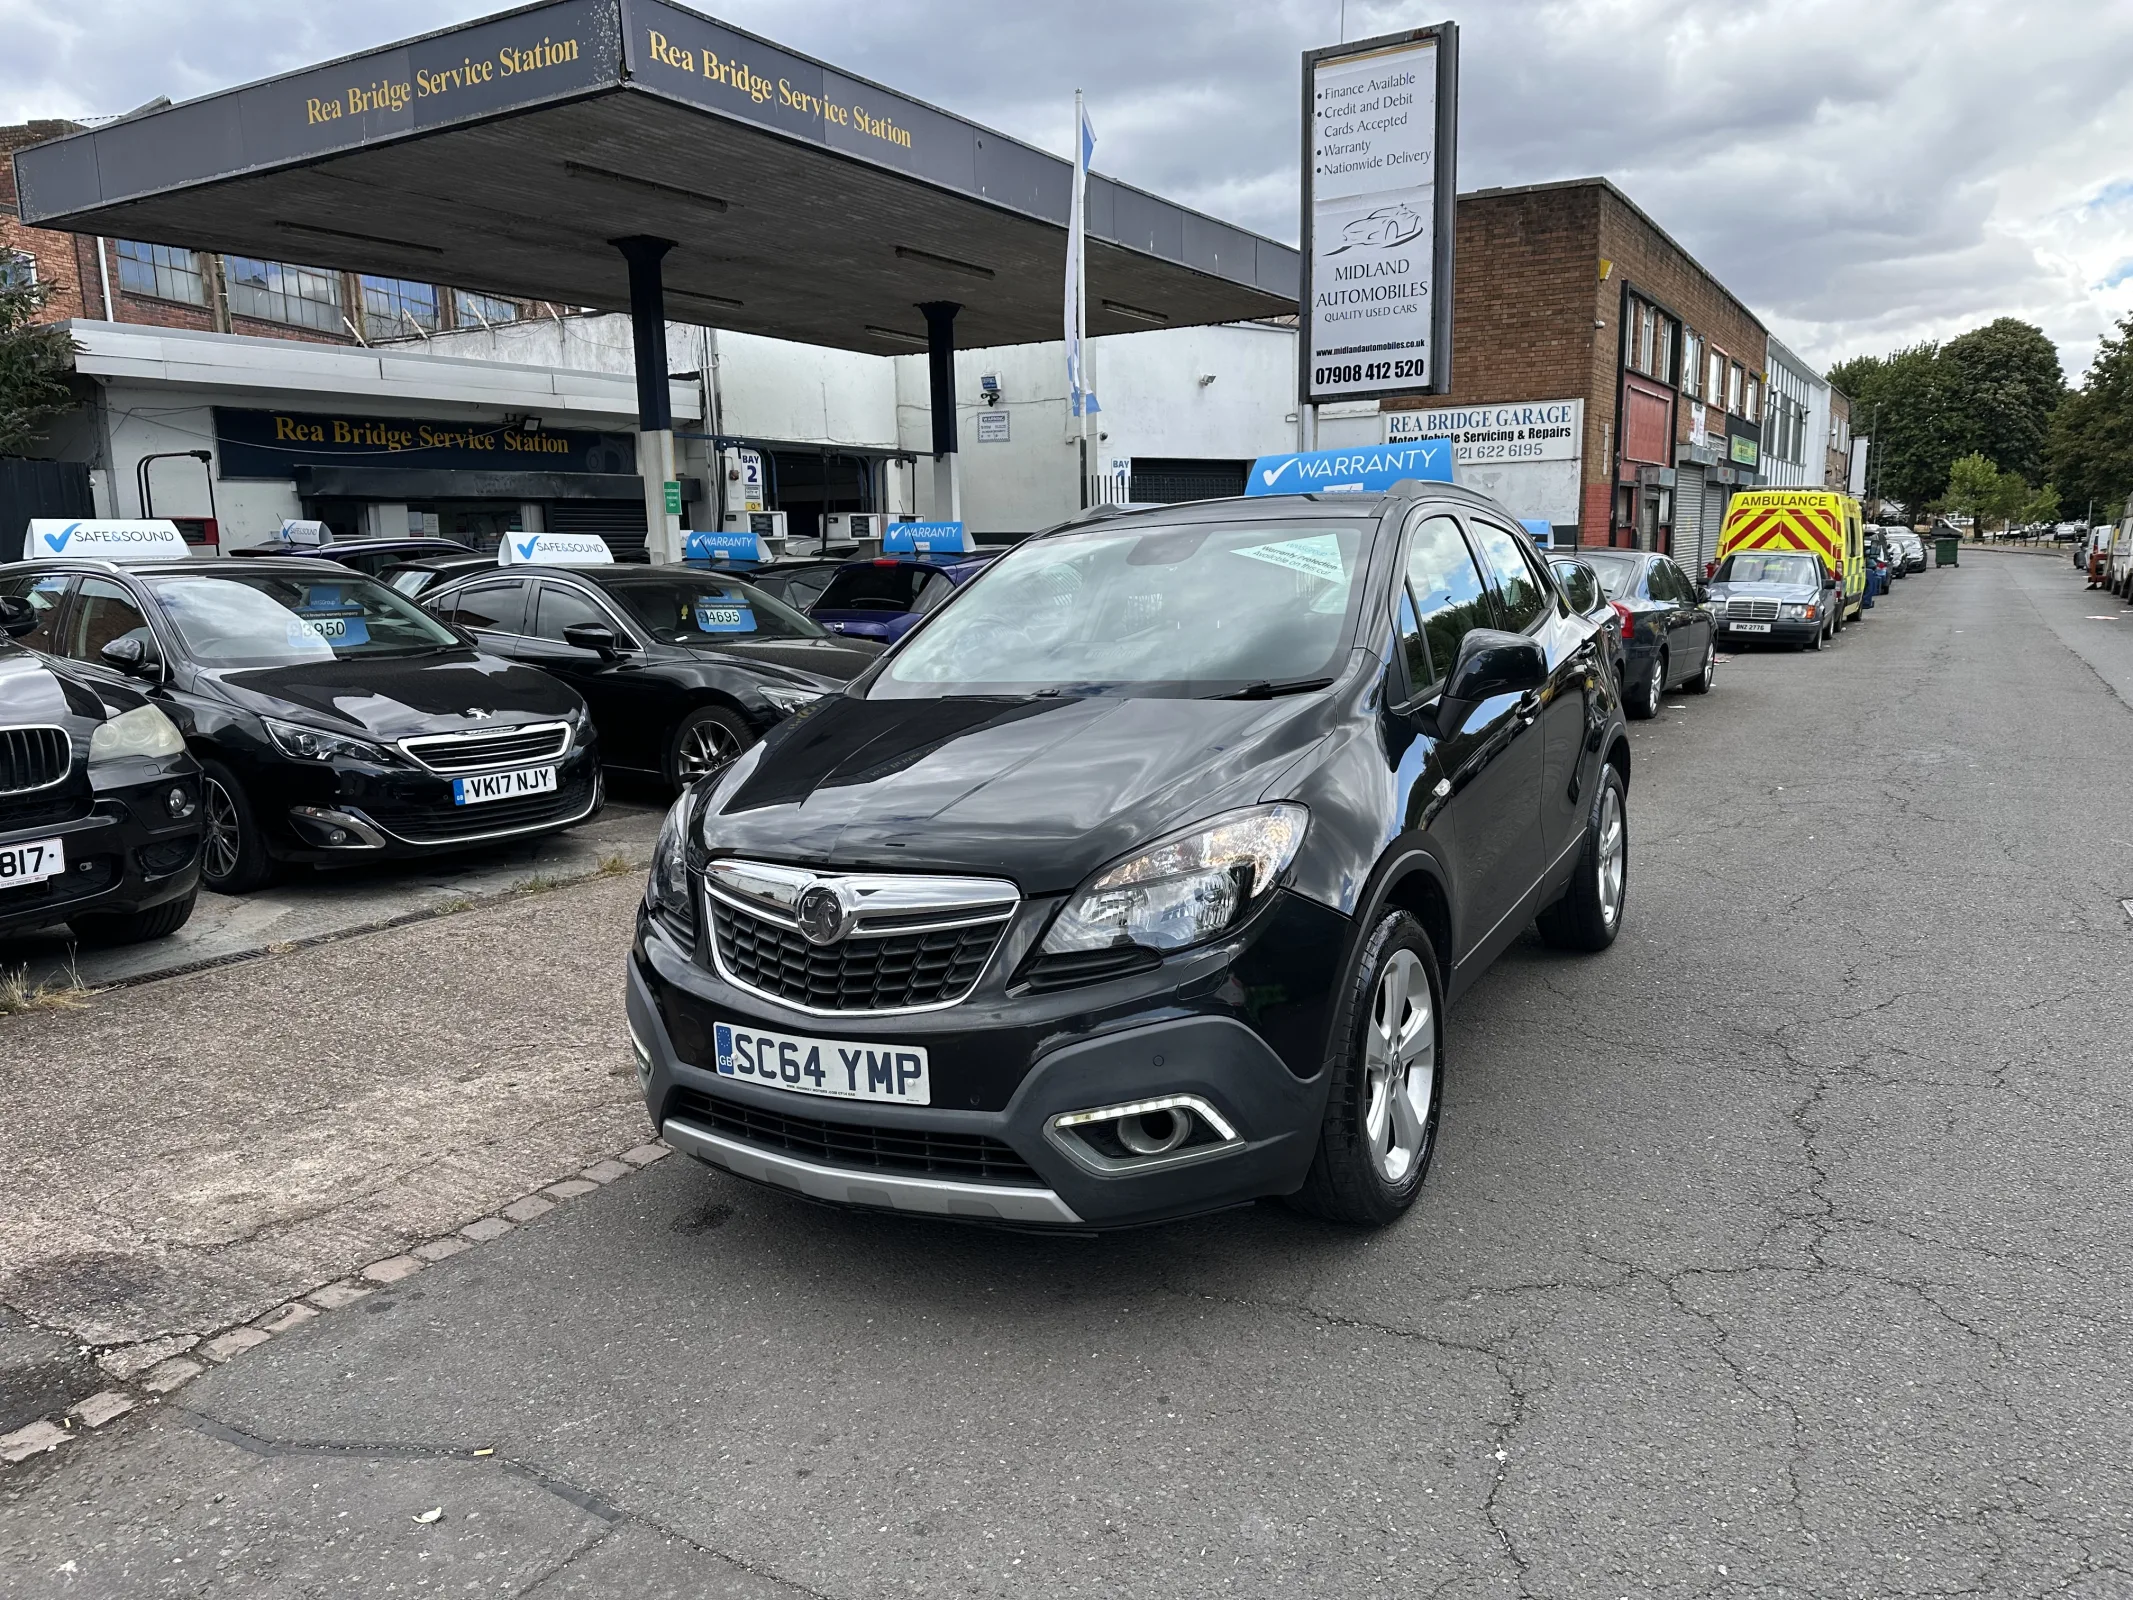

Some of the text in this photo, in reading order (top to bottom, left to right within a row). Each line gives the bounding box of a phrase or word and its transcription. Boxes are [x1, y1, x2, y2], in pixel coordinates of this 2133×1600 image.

[306, 37, 579, 125] Rea Bridge Service Station
[647, 29, 912, 148] Rea Bridge Service Station
[1325, 72, 1416, 99] Finance Available
[1324, 93, 1413, 118] Credit and Debit
[1324, 112, 1408, 137] Cards Accepted
[1324, 140, 1371, 157] Warranty
[1324, 150, 1432, 175] Nationwide Delivery
[1335, 258, 1410, 281] MIDLAND
[1316, 281, 1428, 307] AUTOMOBILES
[1324, 303, 1418, 322] QUALITY USED CARS
[1316, 339, 1425, 357] www.midlandautomobiles.co.uk
[1315, 358, 1425, 385] 07908 412 520
[1389, 405, 1572, 433] REA BRIDGE GARAGE
[274, 416, 569, 454] Rea Bridge Service Station
[1463, 429, 1514, 444] Servicing
[1517, 430, 1525, 439] &
[1528, 425, 1571, 440] Repairs
[742, 455, 759, 464] BAY
[1477, 444, 1504, 458] 622
[1508, 443, 1543, 457] 6195
[1112, 460, 1129, 468] BAY
[1298, 448, 1438, 479] WARRANTY
[747, 465, 758, 483] 2
[1117, 469, 1125, 486] 1
[1741, 496, 1827, 507] AMBULANCE
[74, 531, 174, 542] SAFE&SOUND
[703, 536, 753, 547] WARRANTY
[904, 526, 958, 538] WARRANTY
[536, 542, 604, 553] SAFE&SOUND
[1262, 545, 1338, 570] Warranty Protection
[1253, 550, 1289, 563] Available
[1301, 563, 1315, 571] this
[697, 611, 740, 624] £4695
[470, 769, 549, 798] VK17 NJY
[719, 1055, 733, 1067] GB
[734, 1033, 922, 1095] SC64 YMP
